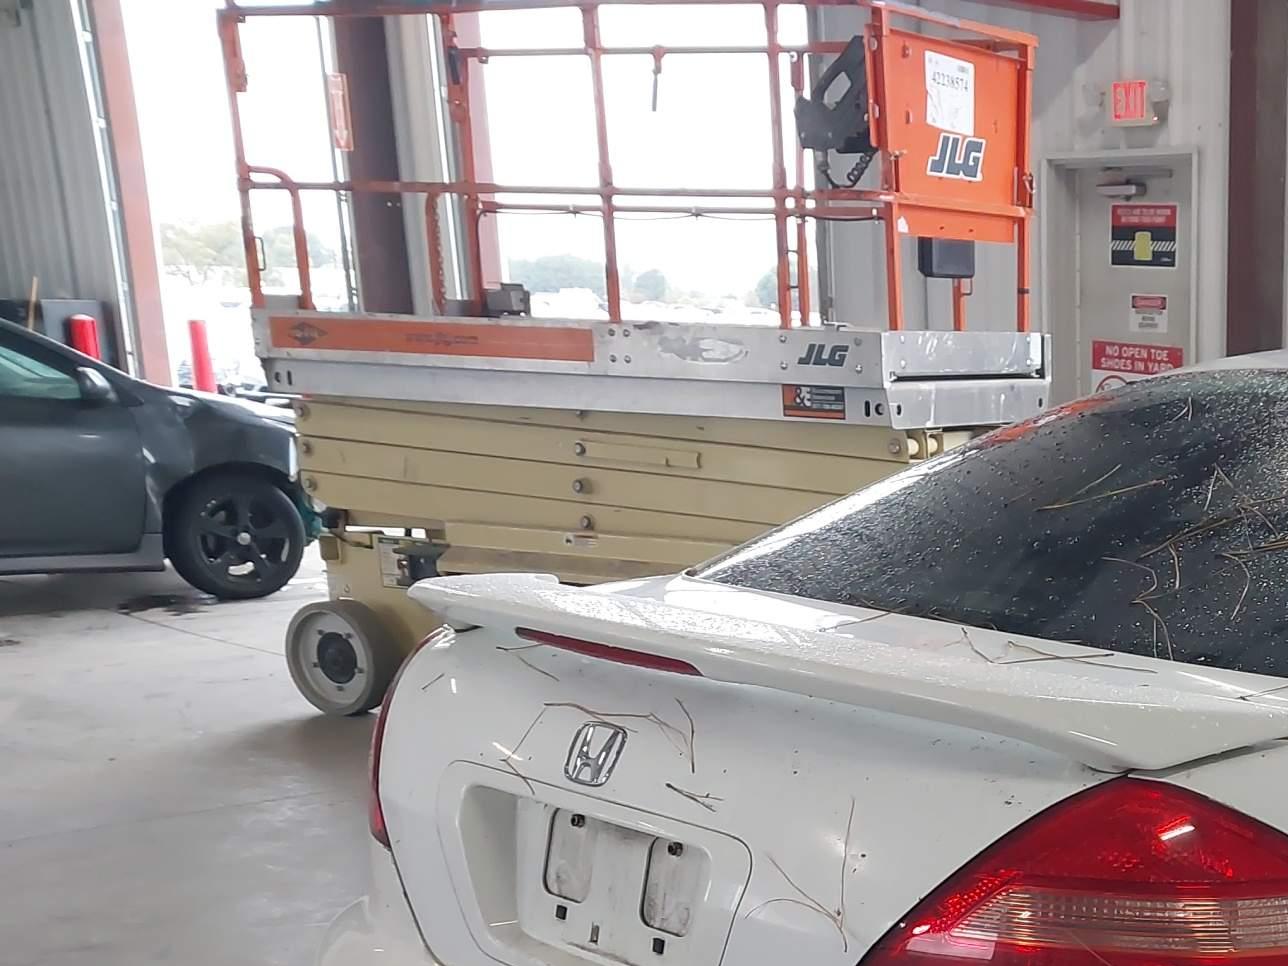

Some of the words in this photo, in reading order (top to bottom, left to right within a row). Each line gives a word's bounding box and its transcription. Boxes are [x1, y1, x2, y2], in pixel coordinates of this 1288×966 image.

[1113, 83, 1146, 119] EXIT
[929, 134, 984, 179] JLG
[797, 343, 849, 367] JLG
[1100, 357, 1132, 370] SHOES
[1134, 361, 1145, 372] IN
[1105, 345, 1119, 356] NO
[1122, 347, 1147, 359] OPEN
[1150, 348, 1169, 361] TOE
